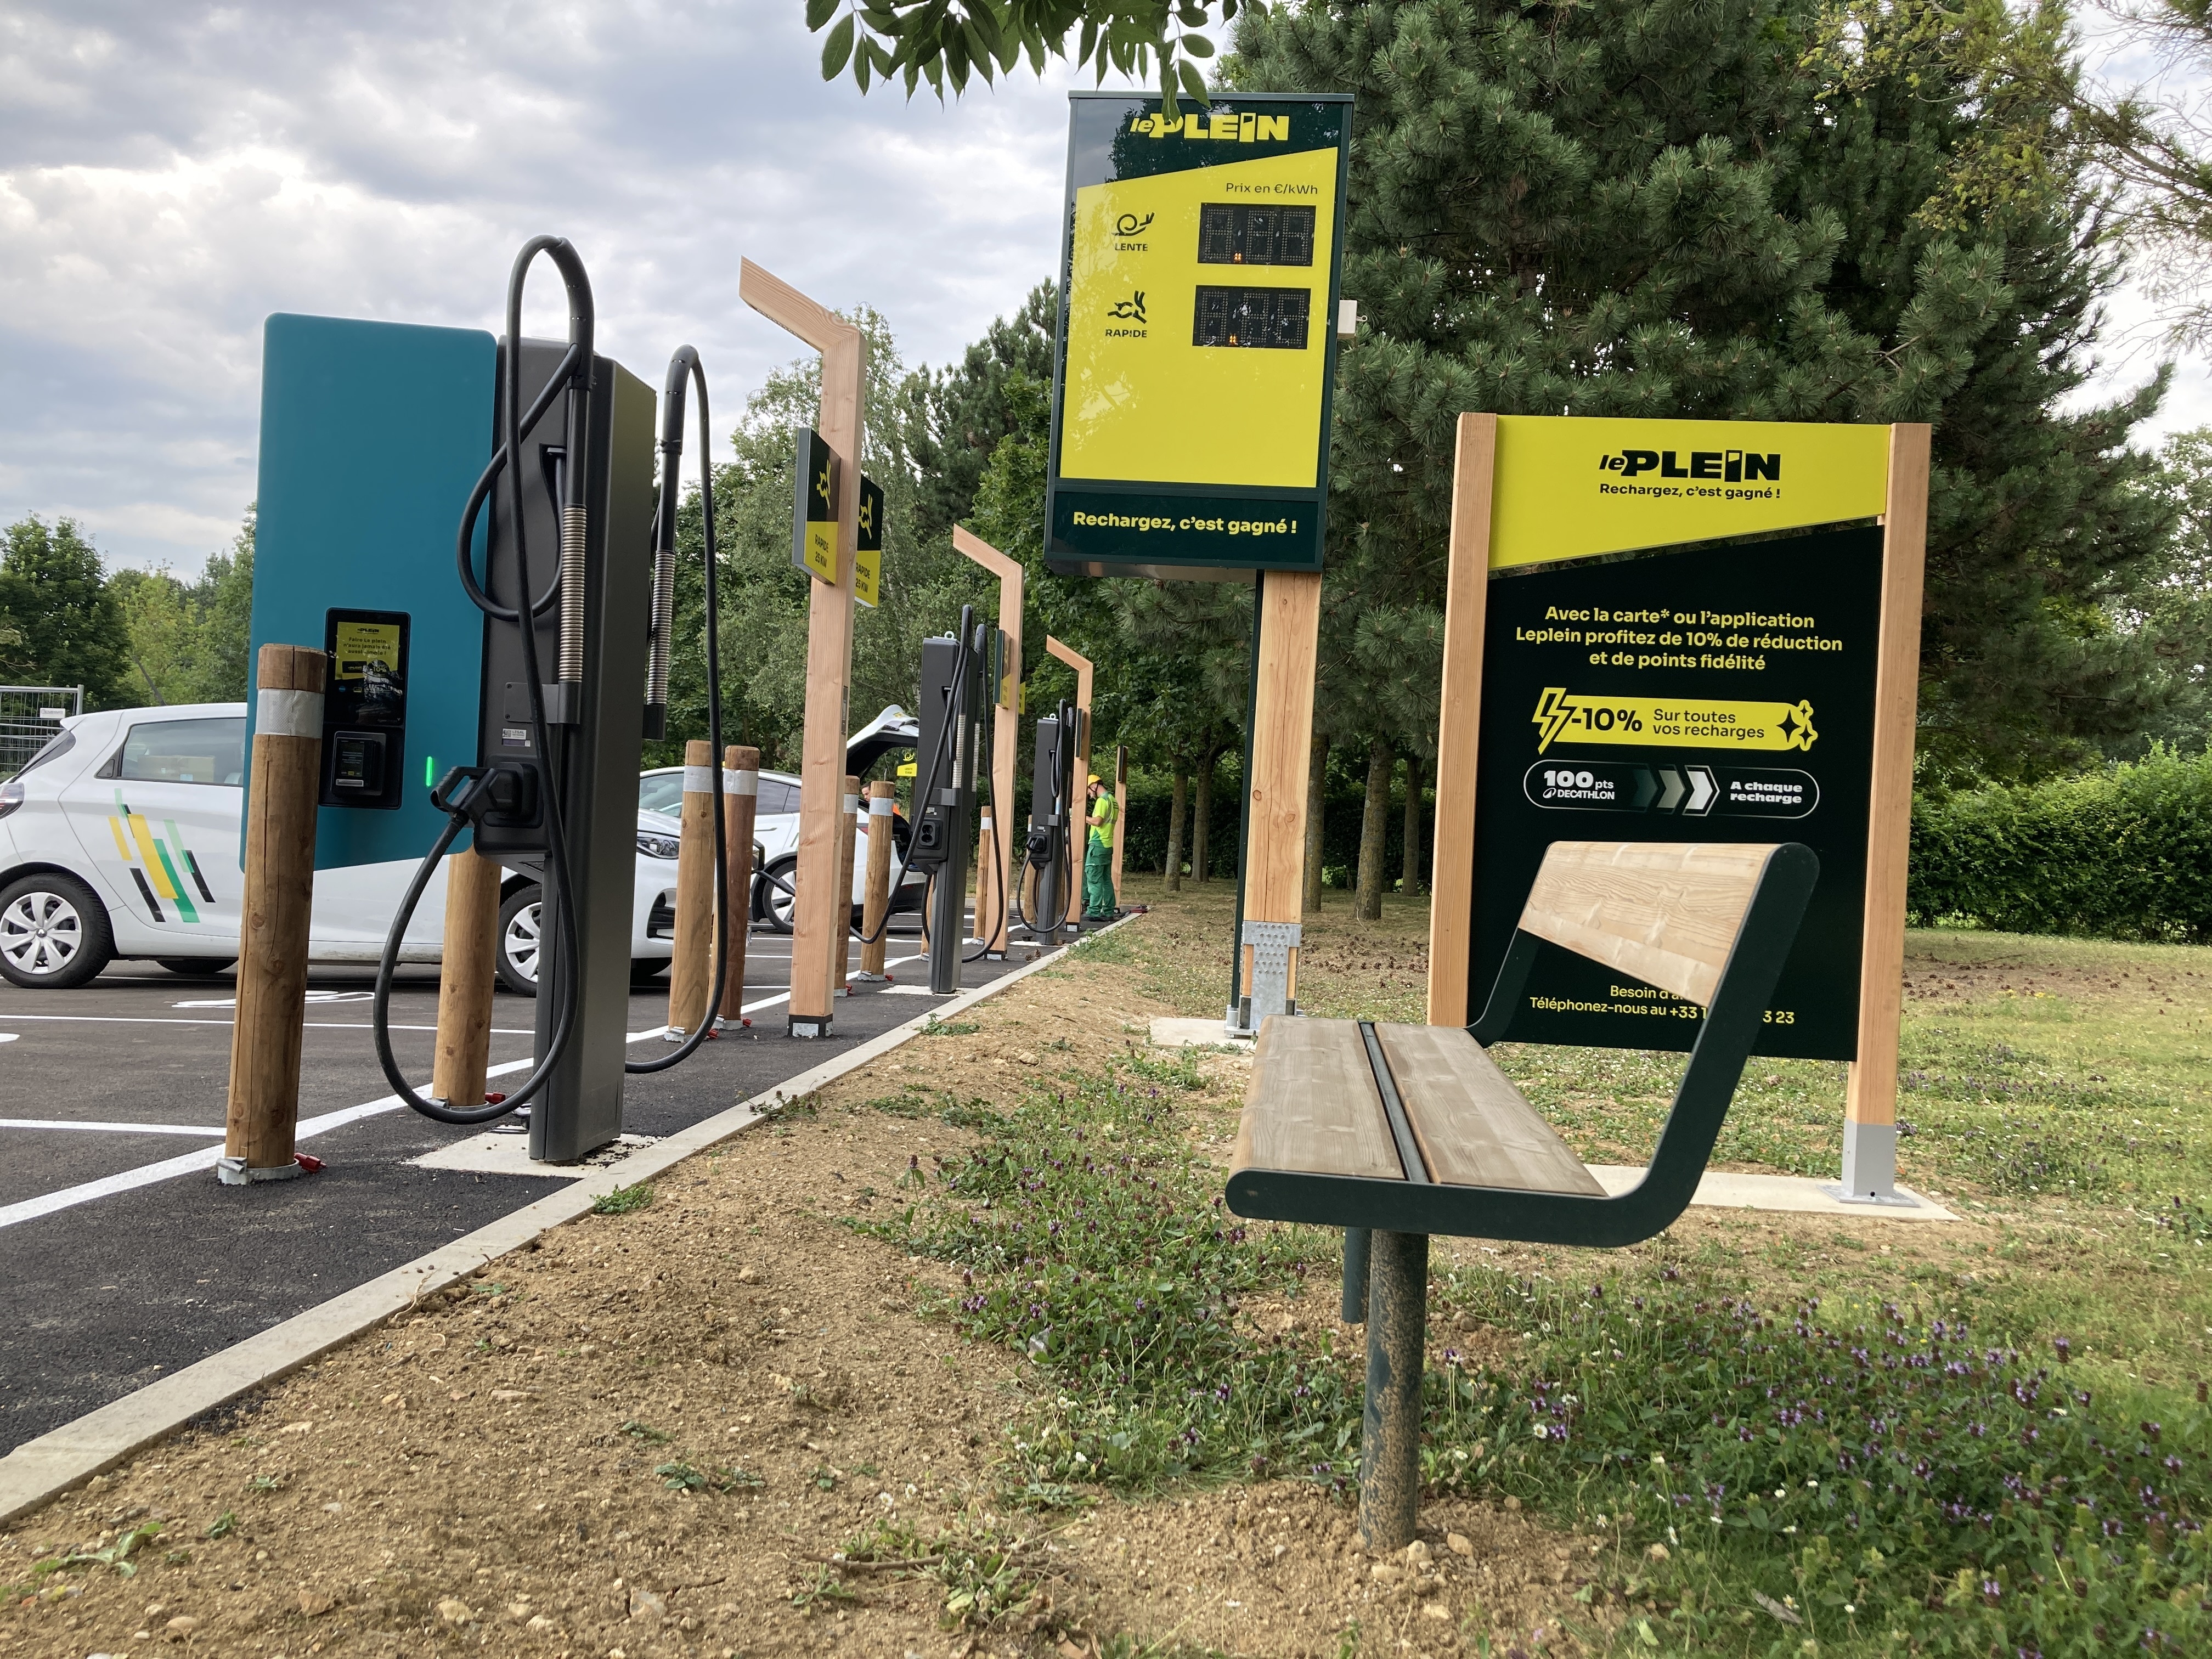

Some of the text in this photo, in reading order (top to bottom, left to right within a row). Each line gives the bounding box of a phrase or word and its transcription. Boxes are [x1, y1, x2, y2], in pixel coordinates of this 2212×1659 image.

[1226, 183, 1318, 195] Prix en €/kWh
[1115, 243, 1148, 252] LENTE
[1105, 329, 1147, 338] RAPIDE
[1600, 483, 1780, 500] Rechargez, c’est gagné !
[1074, 512, 1296, 535] Rechargez, c’est gagné !
[815, 534, 829, 552] RAPIDE
[815, 551, 820, 563] 25
[856, 562, 870, 579] RAPIDE
[856, 578, 868, 593] 25 KW
[1545, 606, 1590, 621] Avec
[1594, 607, 1609, 622] la
[1674, 613, 1696, 624] ou
[1701, 611, 1814, 629] l’application
[1516, 627, 1842, 651] Leplein profitez de 10% de réduction
[1589, 651, 1765, 670] et de points fidélité
[1571, 708, 1643, 732] -10%
[1654, 708, 1736, 724] Sur toutes
[1653, 724, 1765, 741] vos recharges
[1544, 770, 1614, 791] 100 pts
[1730, 781, 1803, 794] A chaque
[1557, 789, 1615, 800] DECATHLON
[1730, 791, 1802, 804] recharge
[1610, 985, 1656, 998] Besoin
[1530, 996, 1647, 1015] Téléphonez-nous
[1650, 1006, 1666, 1015] au
[1670, 1006, 1697, 1019] +33
[1763, 1011, 1772, 1023] 3
[1776, 1011, 1795, 1024] 23
